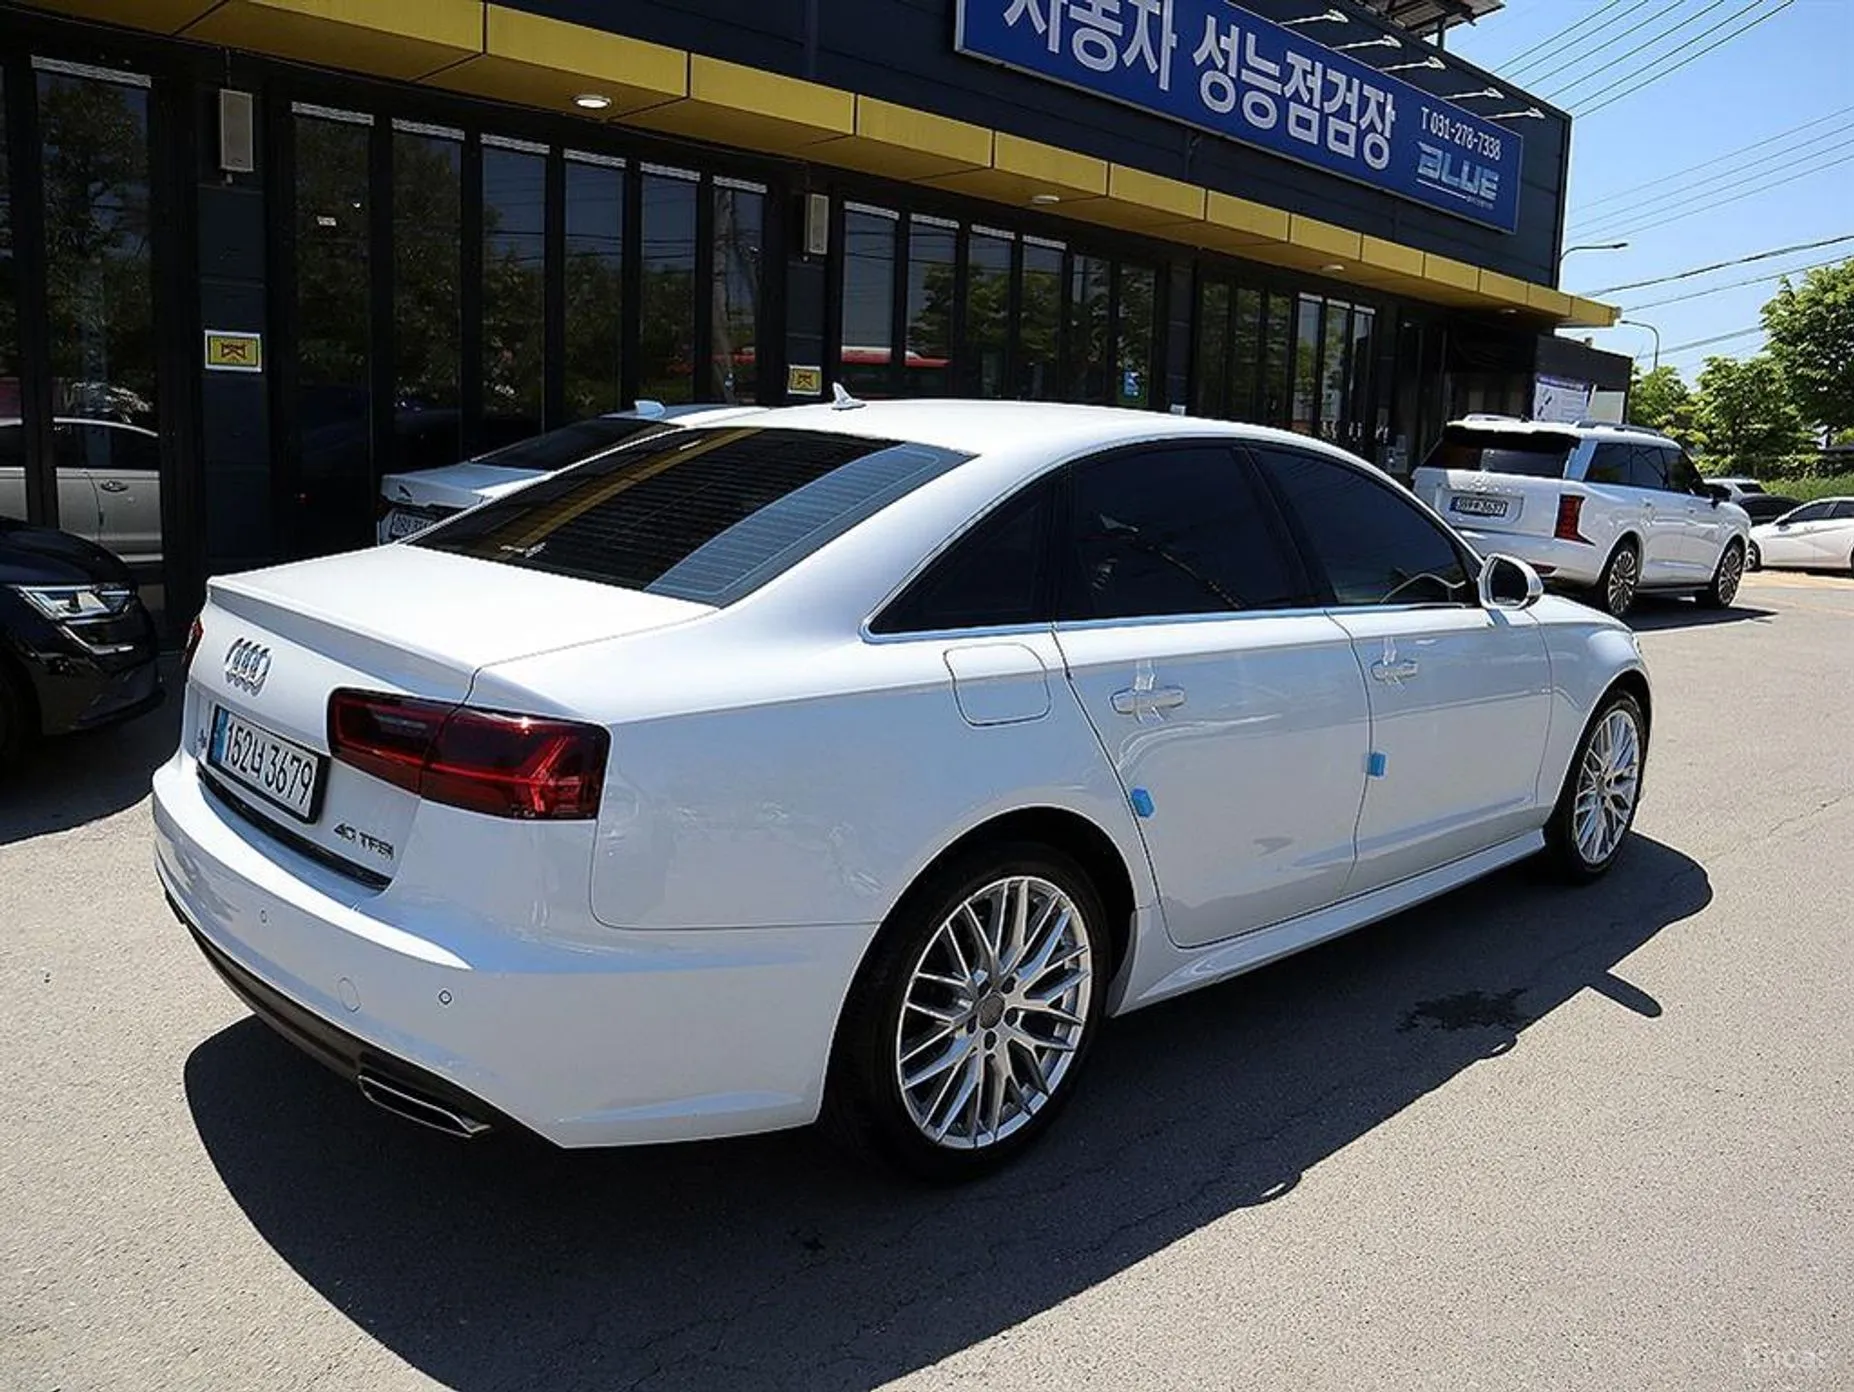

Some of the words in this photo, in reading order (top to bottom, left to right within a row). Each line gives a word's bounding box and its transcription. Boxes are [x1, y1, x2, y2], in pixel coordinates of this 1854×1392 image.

[1193, 14, 1396, 170] 성능점검장
[1421, 106, 1429, 130] T
[1430, 112, 1501, 161] 031-278-7338
[1417, 141, 1499, 200] BLUE
[265, 744, 313, 805] 3679
[333, 823, 356, 842] 40
[359, 831, 394, 861] TFSI
